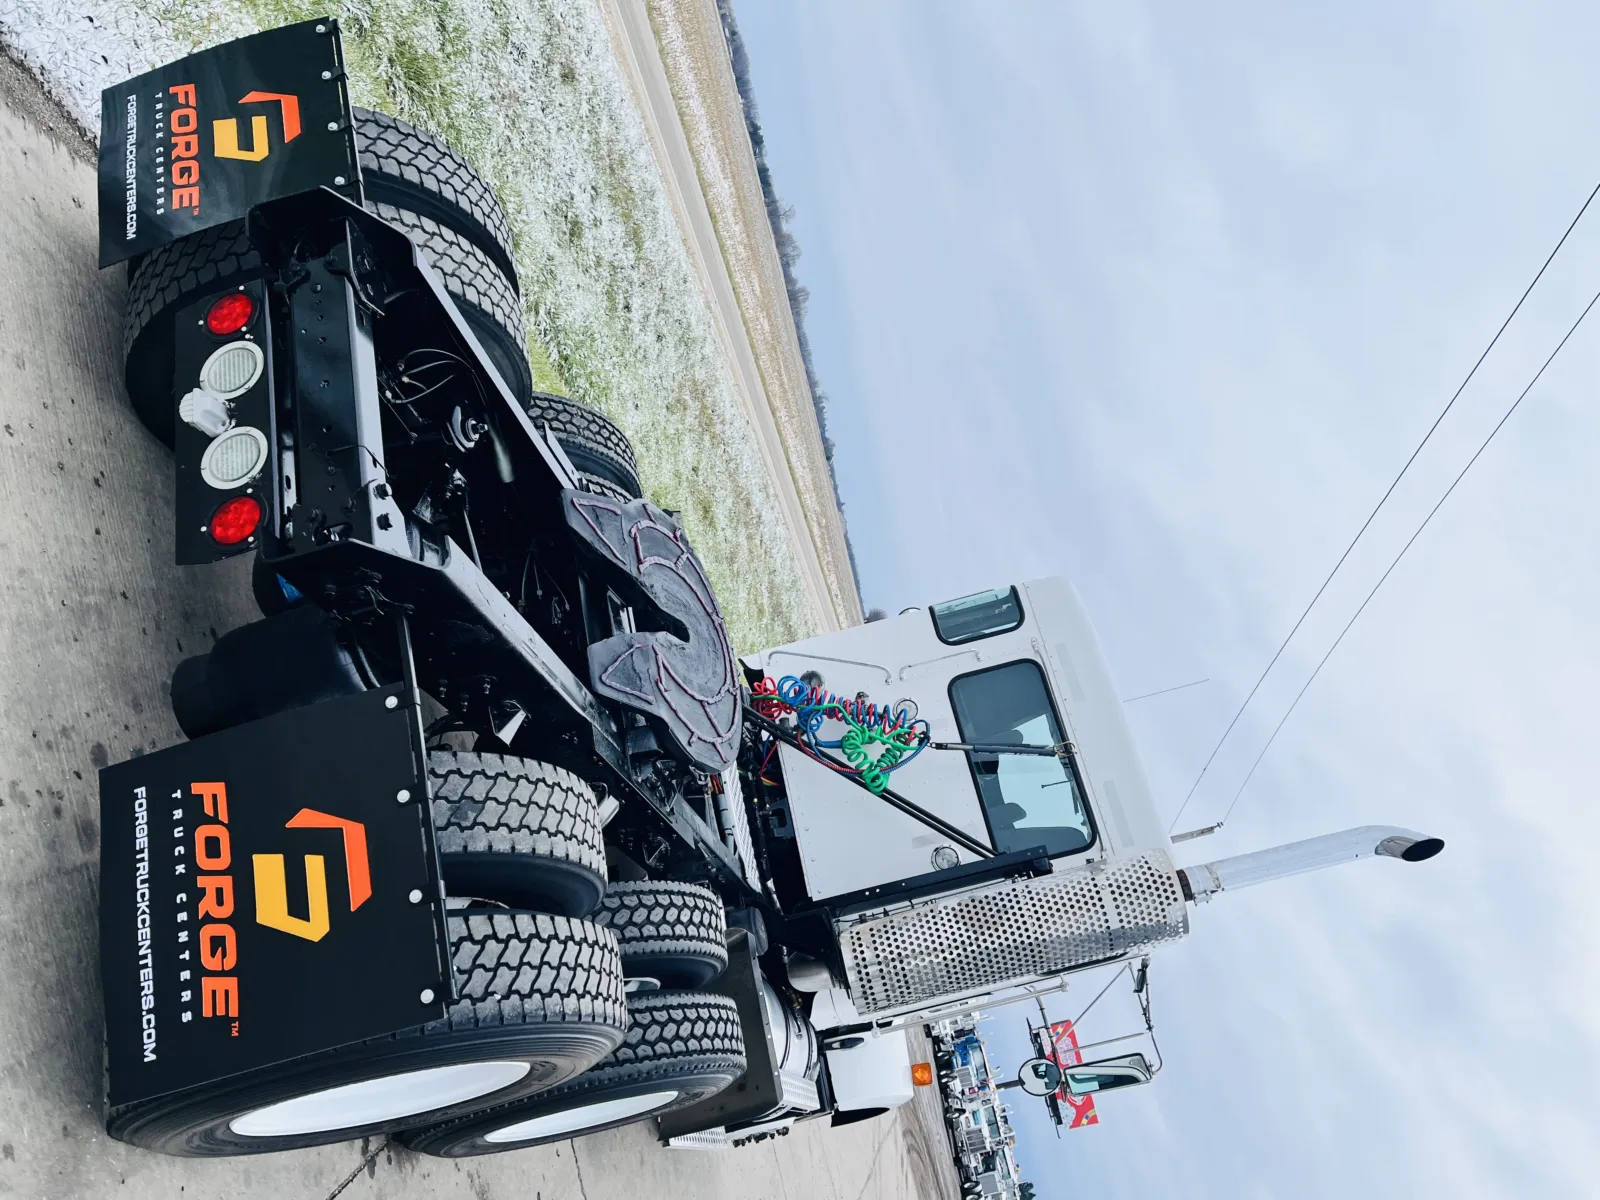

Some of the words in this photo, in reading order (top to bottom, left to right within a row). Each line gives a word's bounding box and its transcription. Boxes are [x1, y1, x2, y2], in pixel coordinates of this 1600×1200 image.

[125, 94, 137, 240] FORGETRUCKCENTERS.COM
[154, 91, 164, 139] TRUCK
[169, 83, 199, 209] FORGE
[155, 146, 165, 215] CENTERS
[171, 788, 186, 876] TRUCK
[133, 786, 157, 1063] FORGETRUCKCENTERS.COM
[176, 892, 193, 1023] CENTERS
[191, 781, 239, 1018] FORGE
